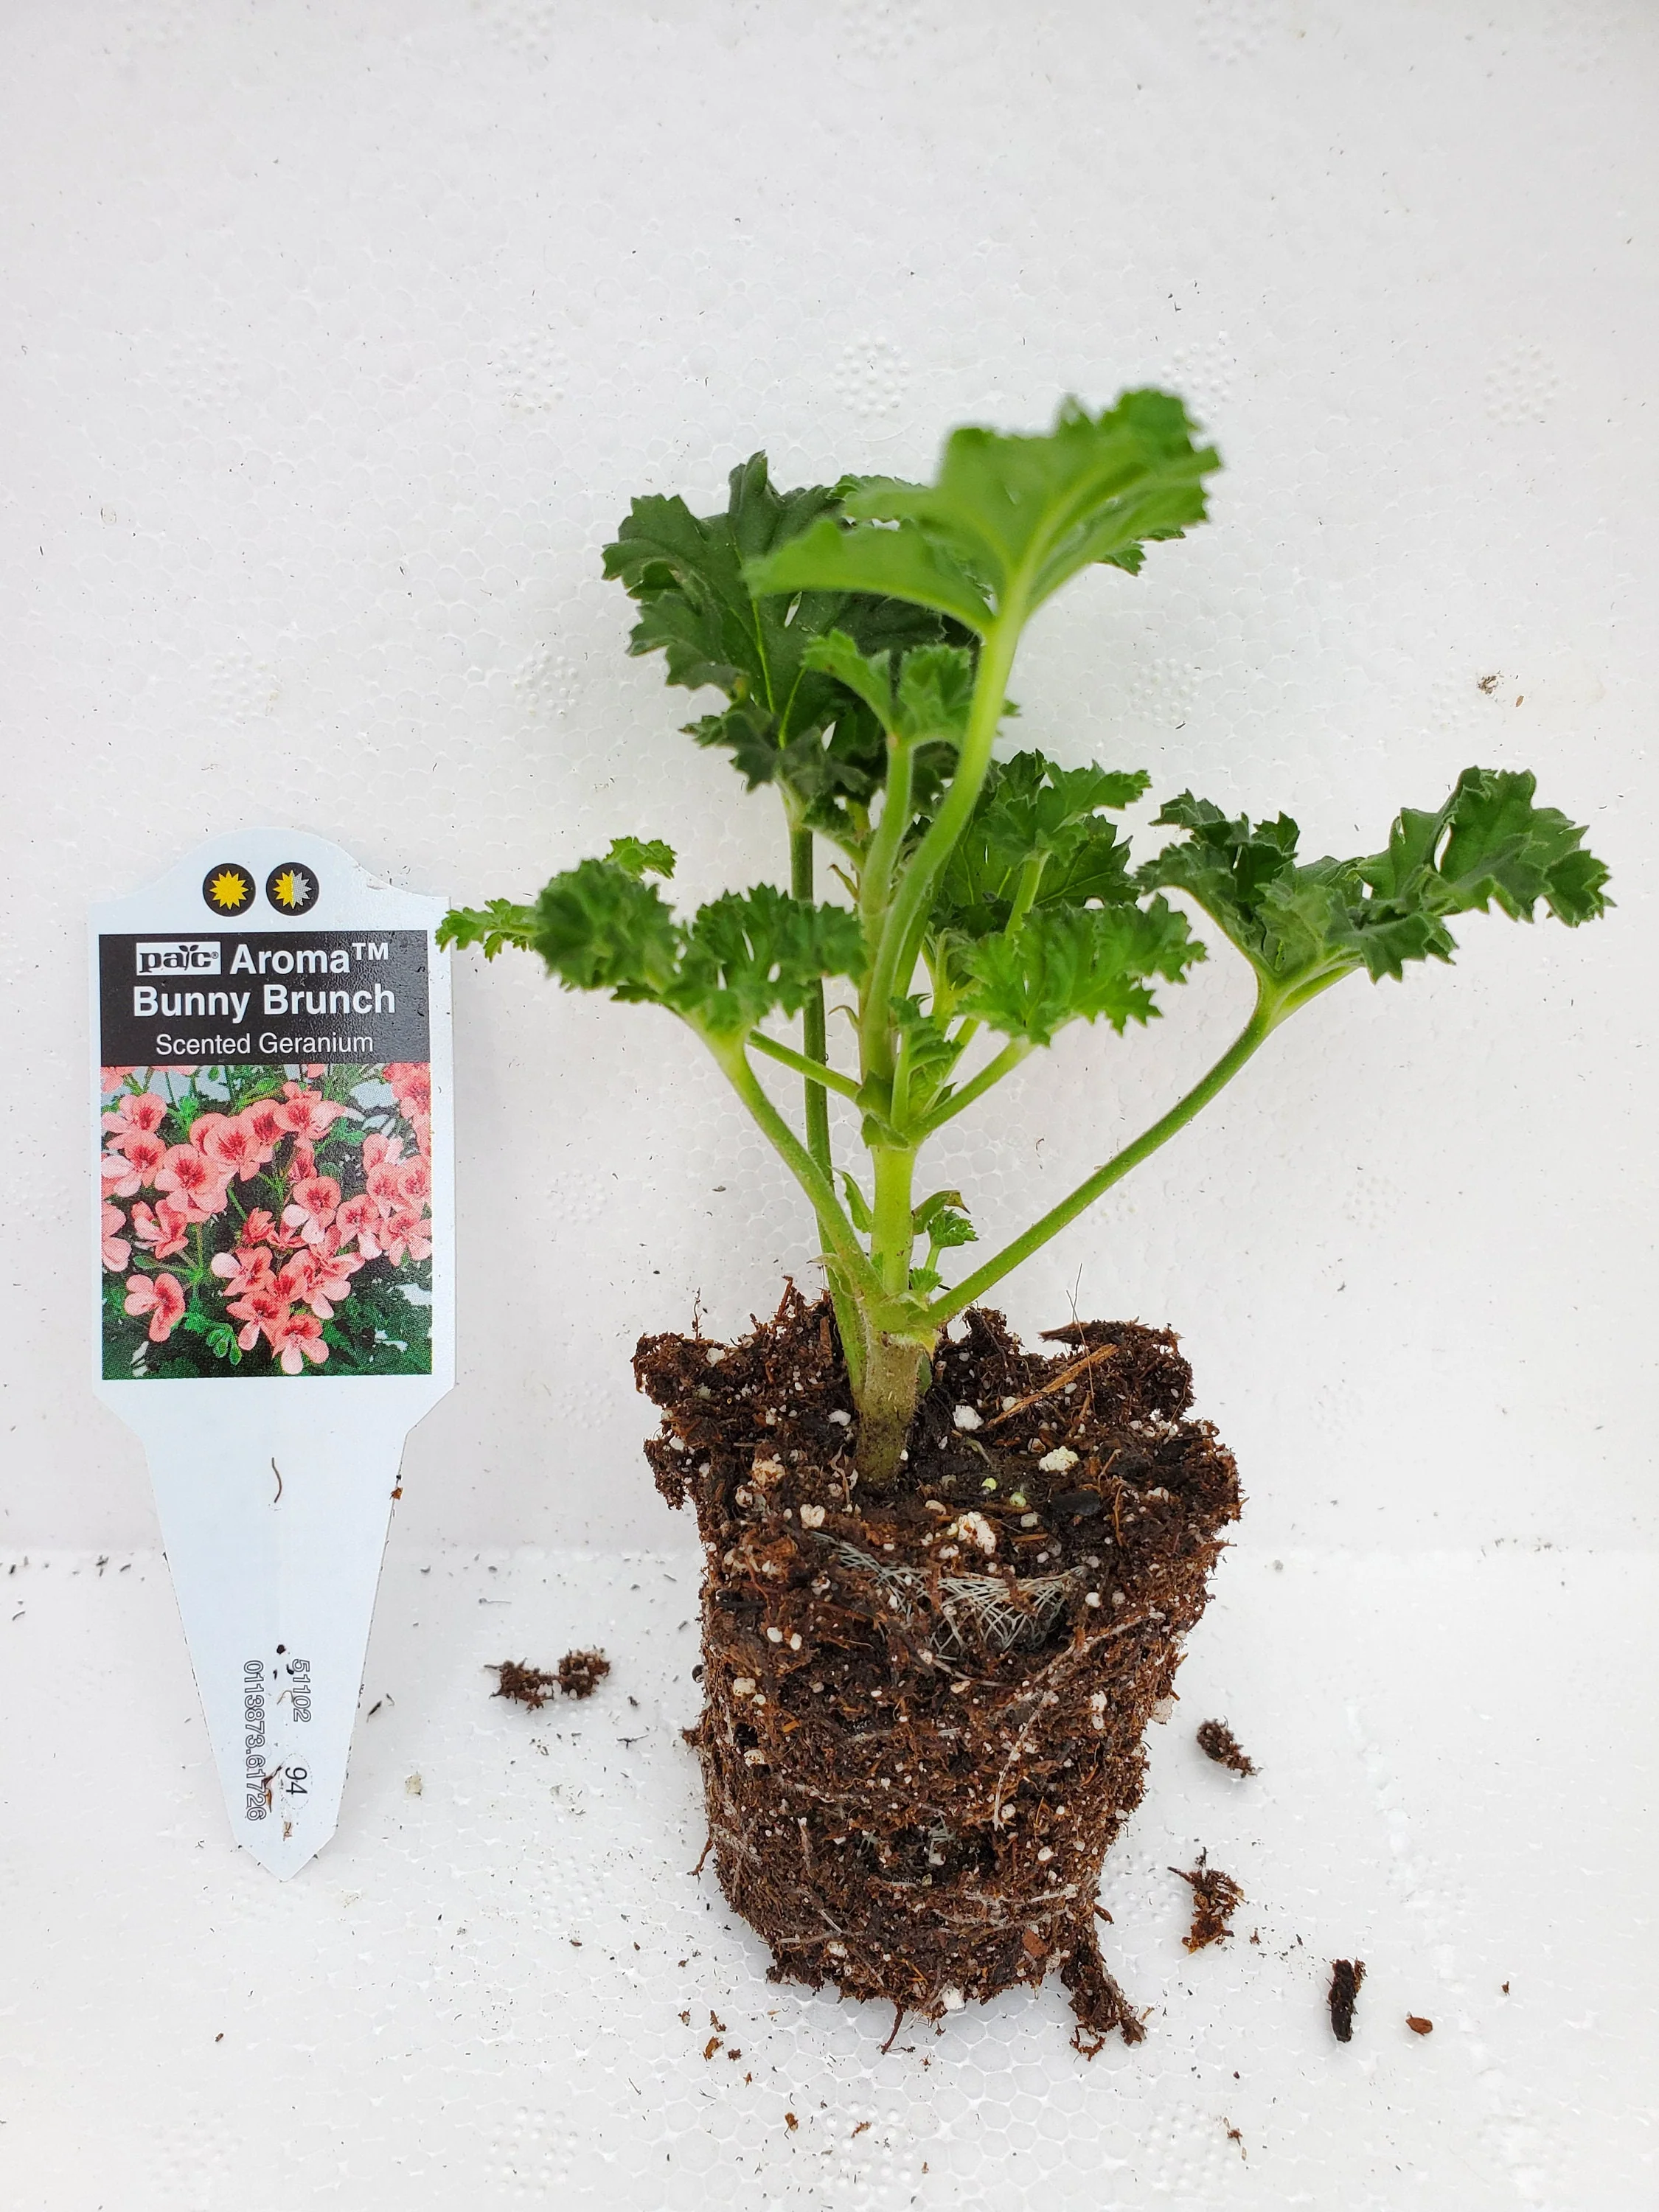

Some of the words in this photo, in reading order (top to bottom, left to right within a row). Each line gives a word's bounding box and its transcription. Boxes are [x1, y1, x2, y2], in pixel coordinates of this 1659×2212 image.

[133, 986, 251, 1024] Bunny
[263, 983, 395, 1015] Brunch
[156, 1034, 251, 1055] Scented
[259, 1032, 374, 1054] Geranium
[291, 1658, 312, 1722] 51102
[243, 1659, 268, 1821] 0113873.61726
[285, 1767, 308, 1795] 94
